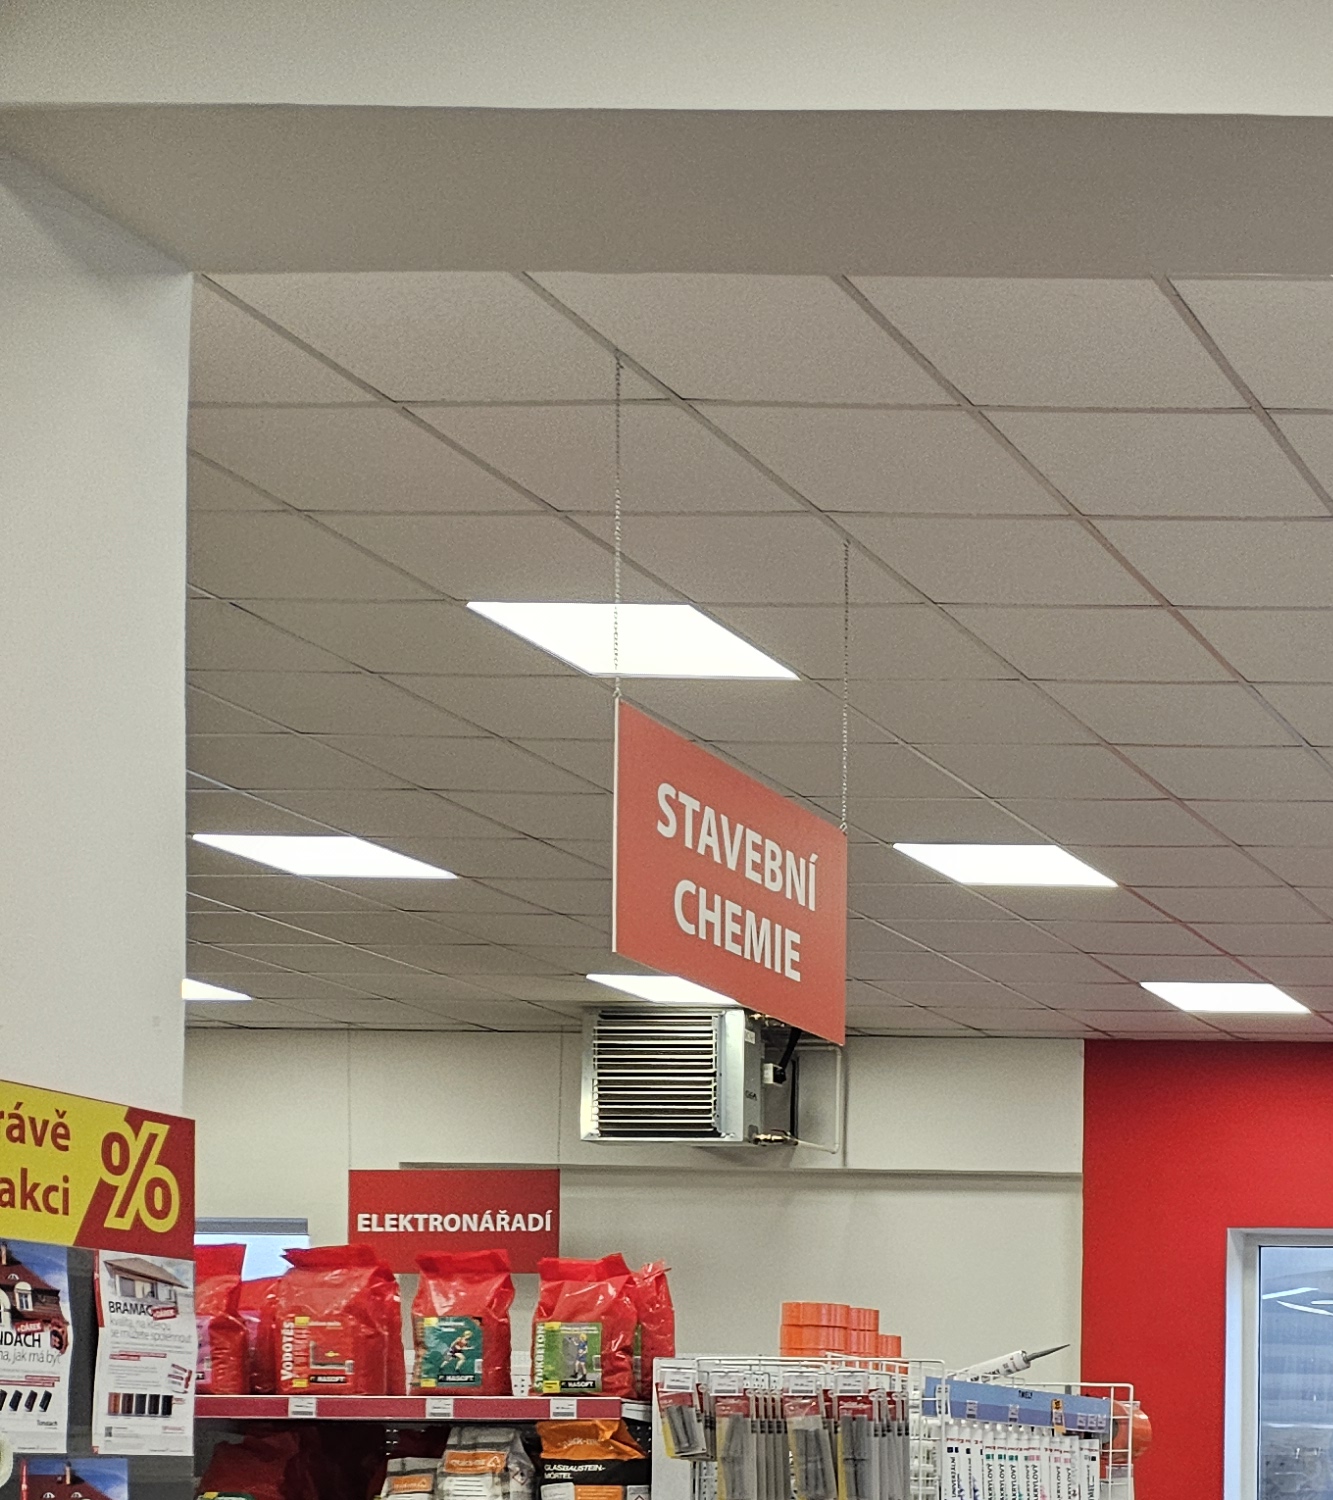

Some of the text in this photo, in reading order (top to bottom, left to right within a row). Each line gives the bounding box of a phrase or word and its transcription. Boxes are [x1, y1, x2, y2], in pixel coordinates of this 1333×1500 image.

[656, 782, 819, 912] STAVEBNÍ
[674, 879, 801, 982] CHEMIE
[0, 1101, 71, 1152] ávě
[0, 1167, 70, 1216] akci
[98, 1120, 181, 1234] %
[356, 1210, 553, 1233] ELEKTRONÁŘADÍ
